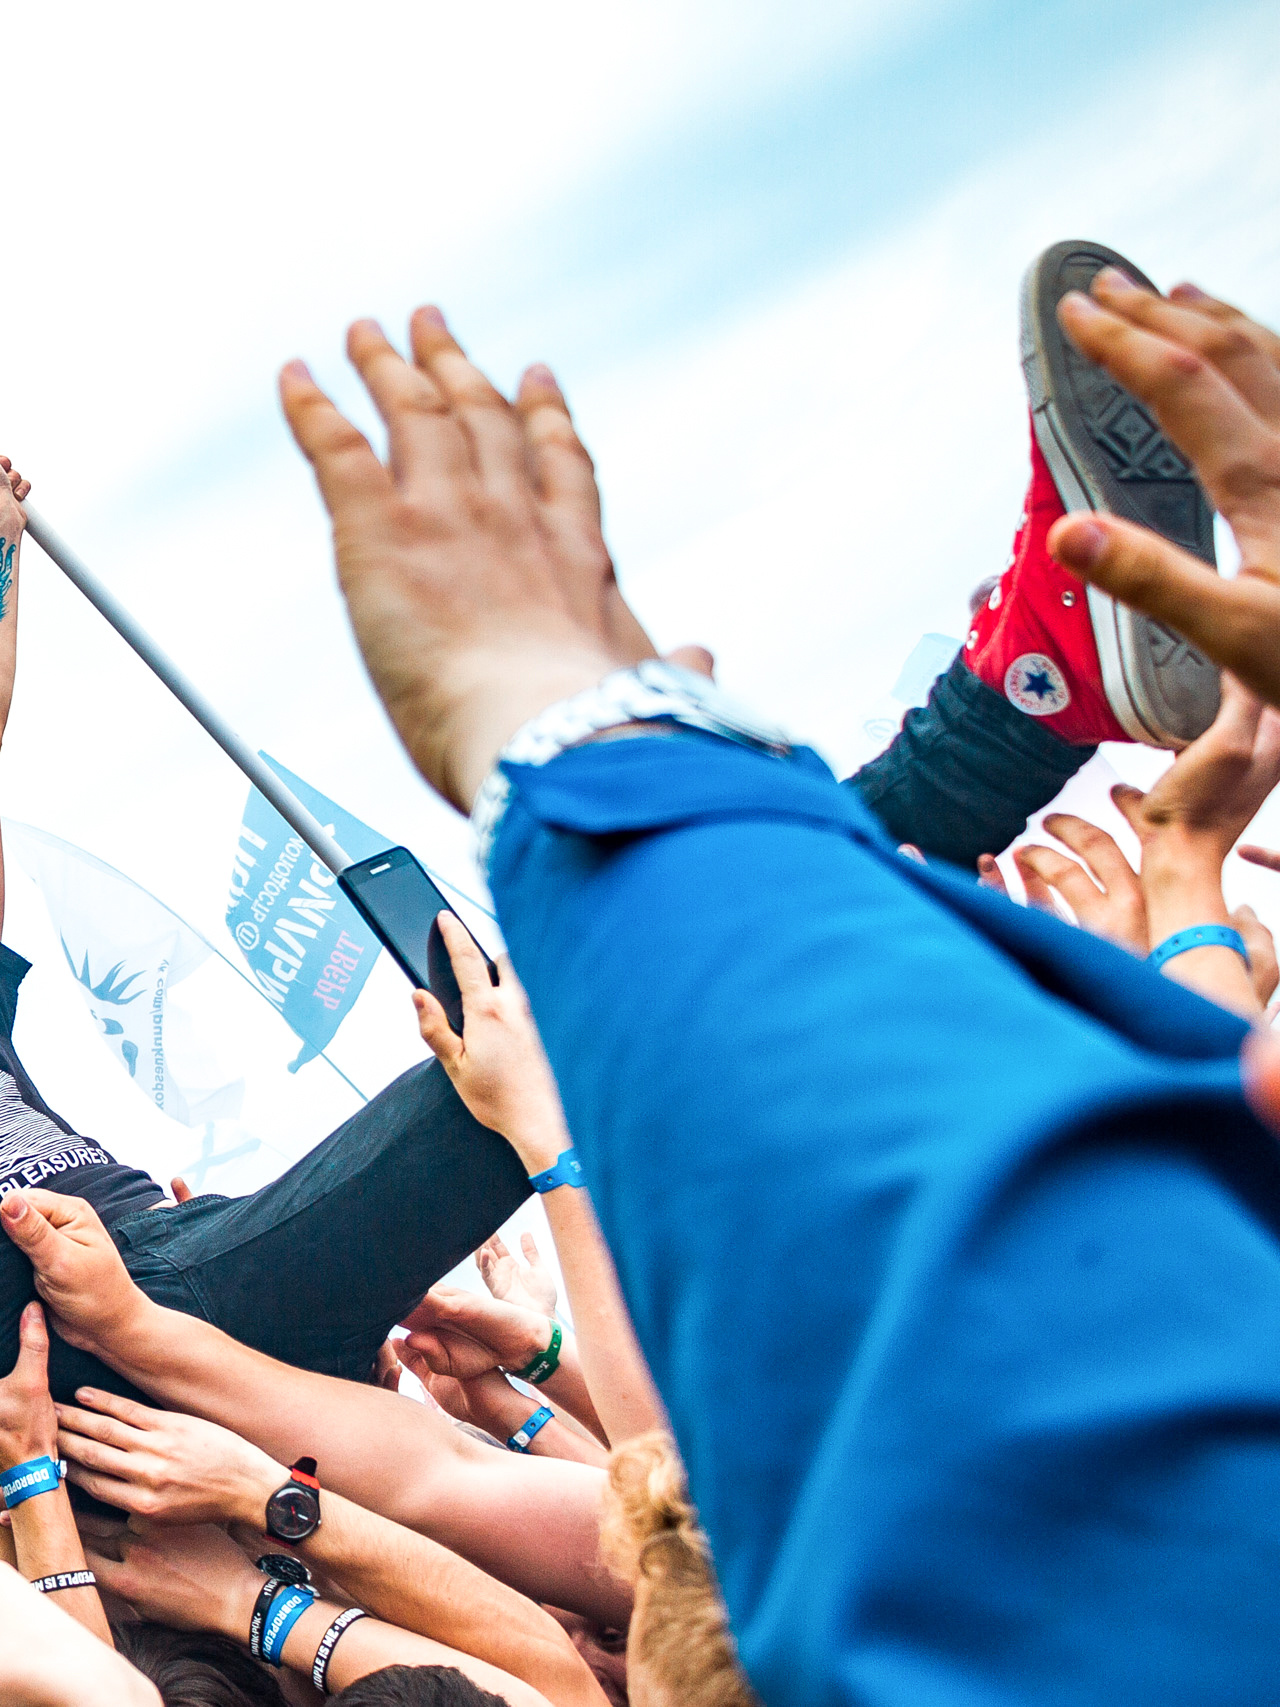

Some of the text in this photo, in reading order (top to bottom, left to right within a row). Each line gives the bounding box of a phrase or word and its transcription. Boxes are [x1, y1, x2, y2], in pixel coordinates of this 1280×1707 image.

[45, 1577, 57, 1590] IS
[323, 1627, 339, 1647] ME
[318, 1645, 330, 1659] IS
